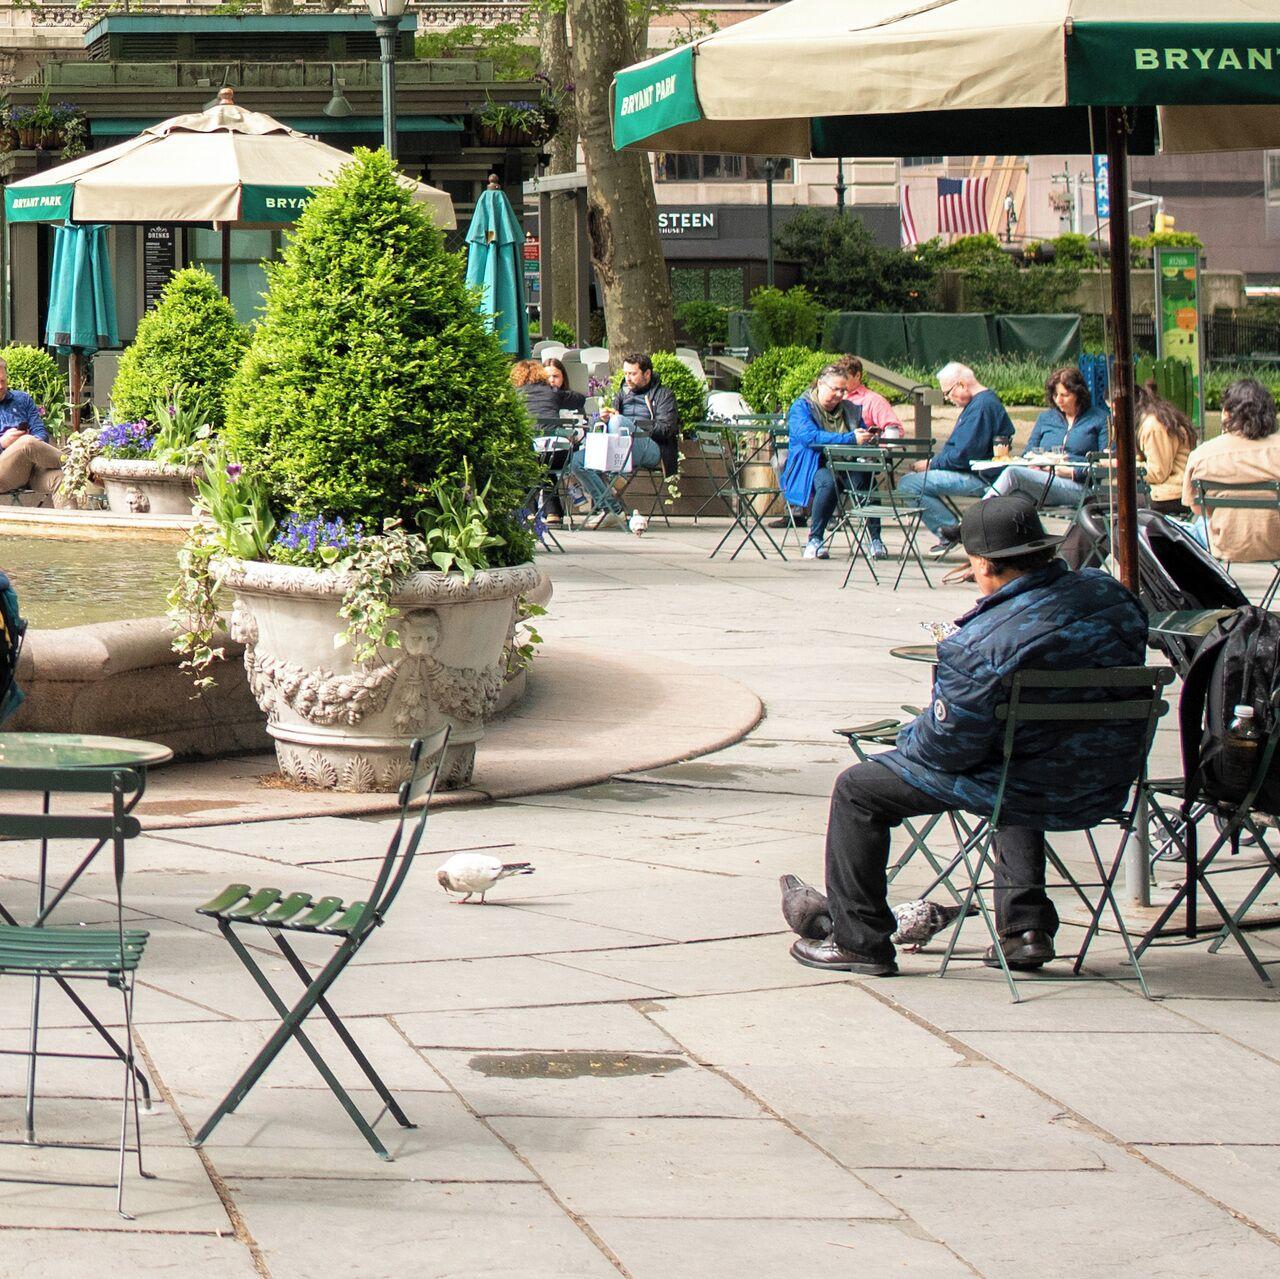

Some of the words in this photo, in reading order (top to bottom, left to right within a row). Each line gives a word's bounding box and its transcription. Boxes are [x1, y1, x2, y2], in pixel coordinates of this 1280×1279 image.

[1134, 48, 1280, 70] BRYAN
[621, 84, 655, 117] BRYANT
[655, 74, 677, 102] PARK
[12, 197, 40, 209] BRYANT
[40, 196, 62, 206] PARK
[658, 213, 714, 227] STEEN
